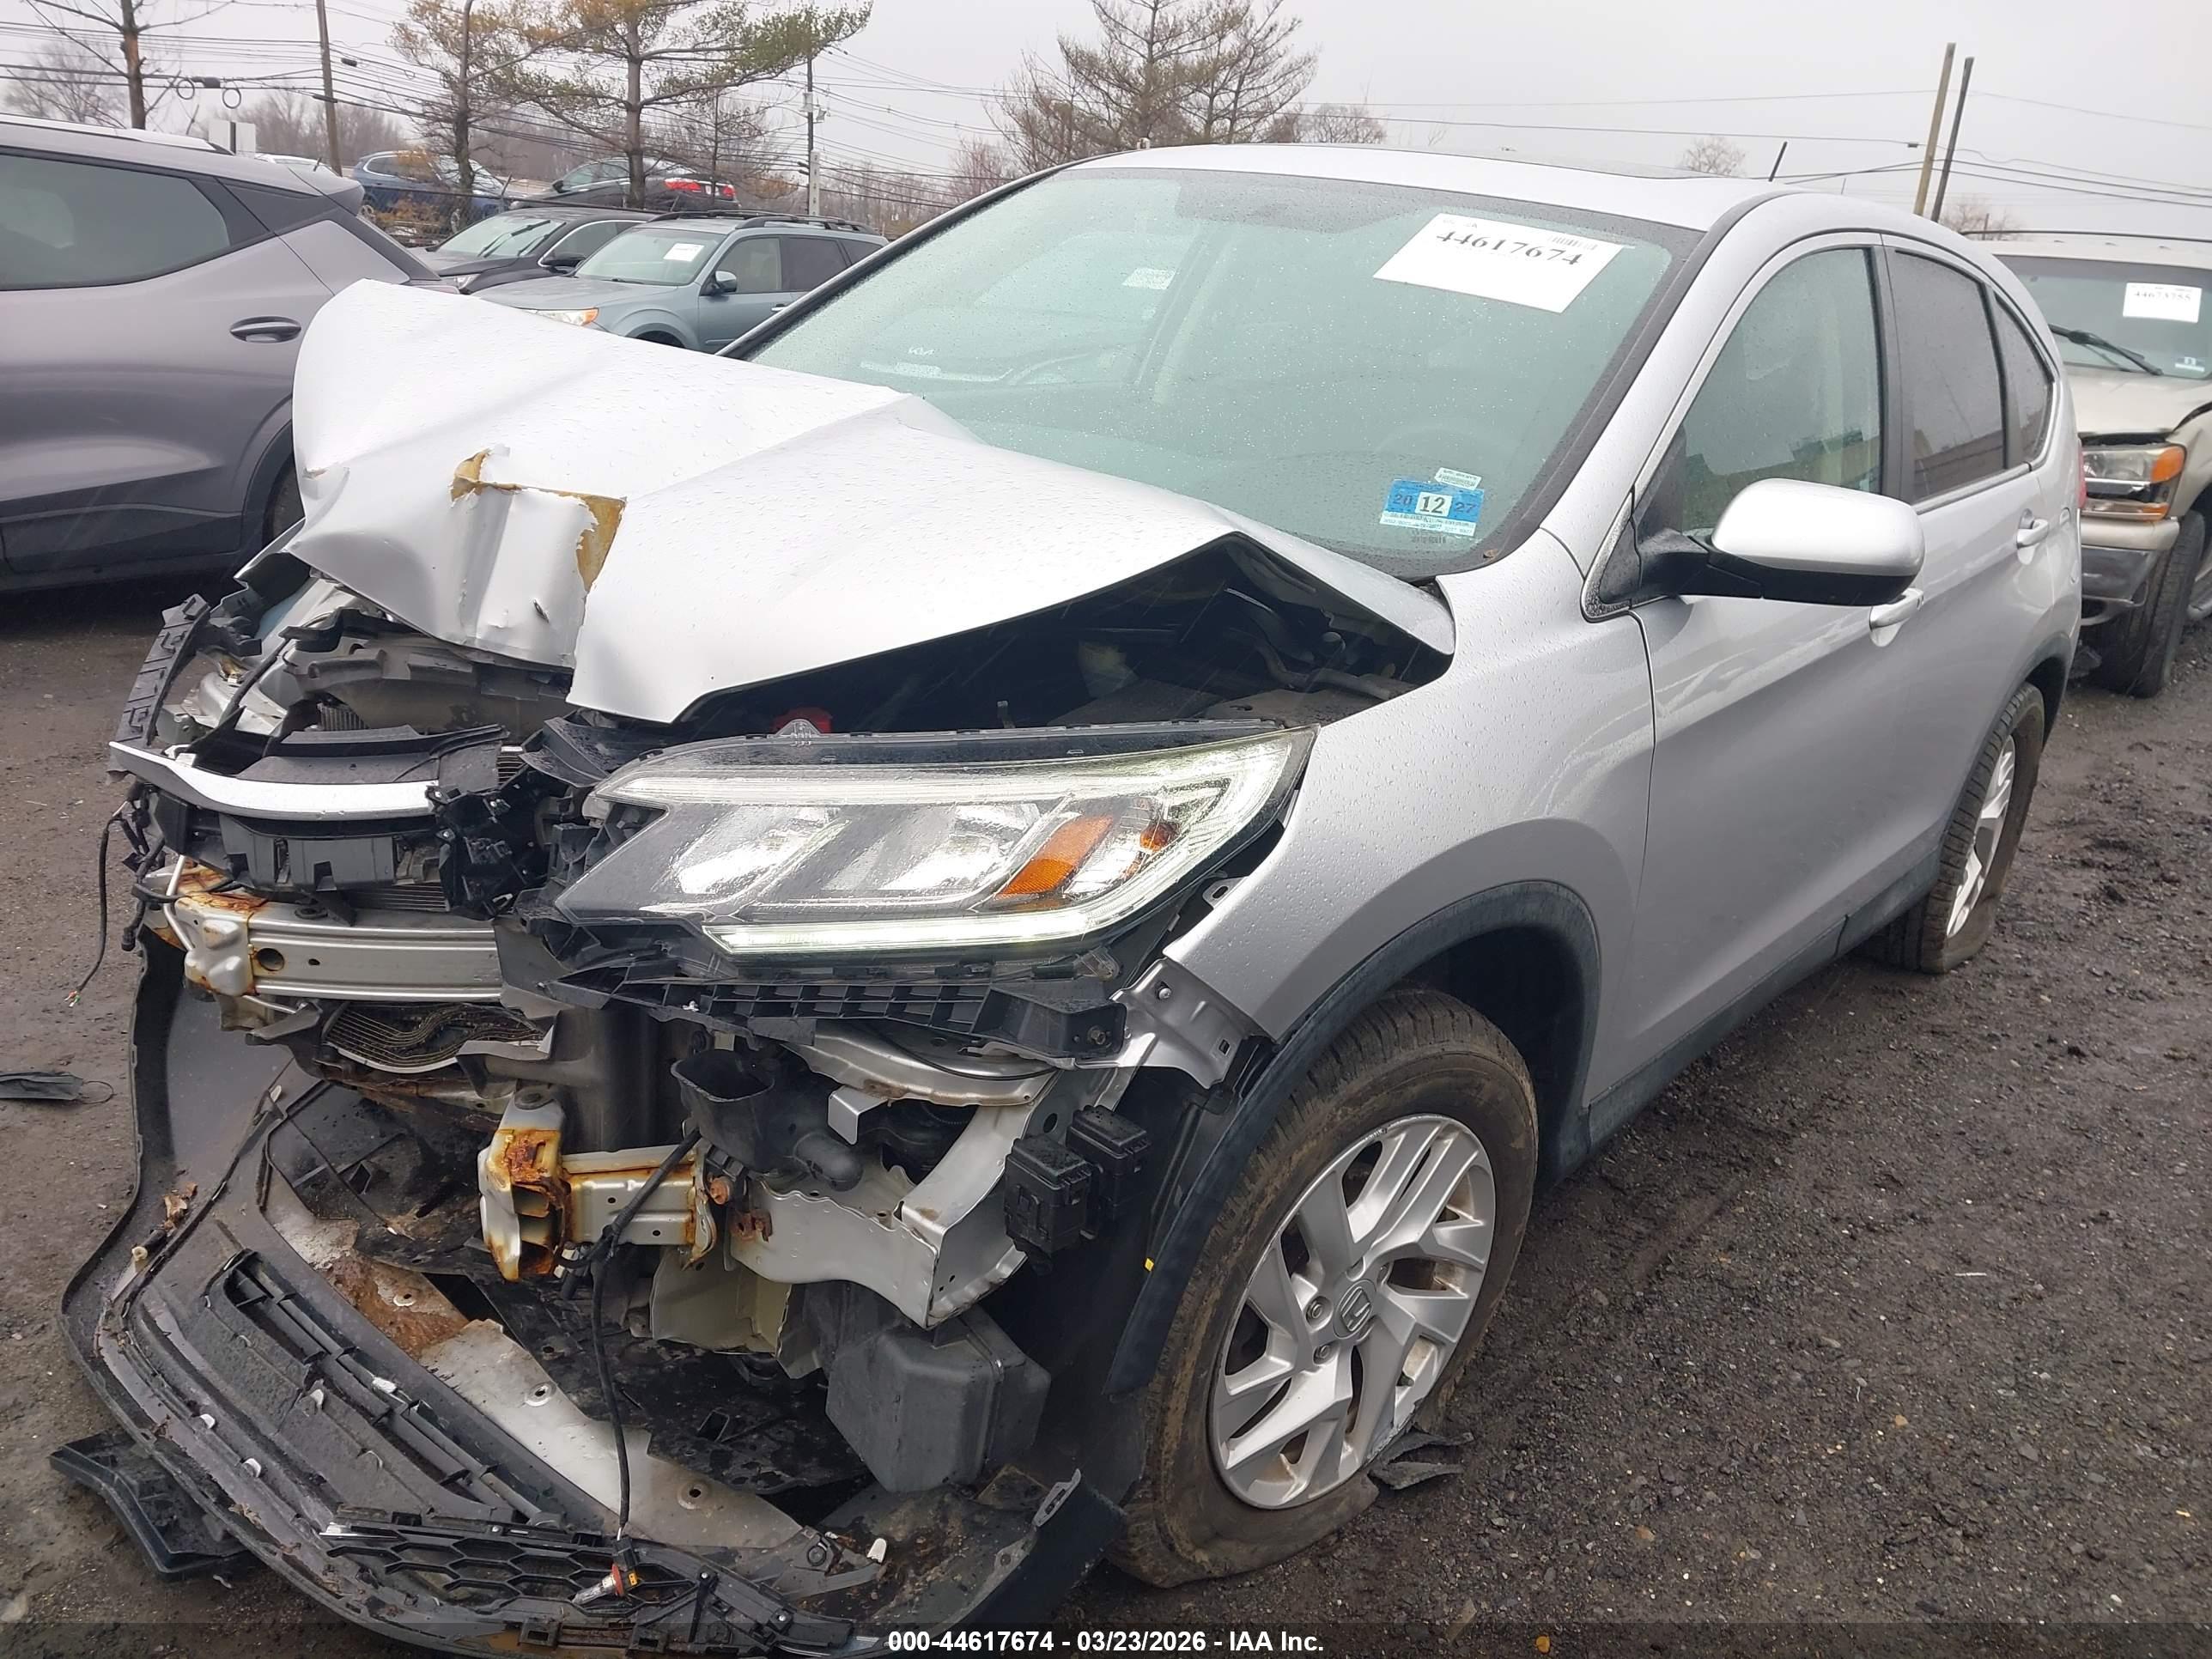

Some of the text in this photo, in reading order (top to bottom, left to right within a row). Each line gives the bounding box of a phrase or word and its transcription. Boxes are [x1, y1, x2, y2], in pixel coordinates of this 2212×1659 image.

[1436, 229, 1583, 265] 44617674
[1392, 493, 1477, 514] 20 12 27
